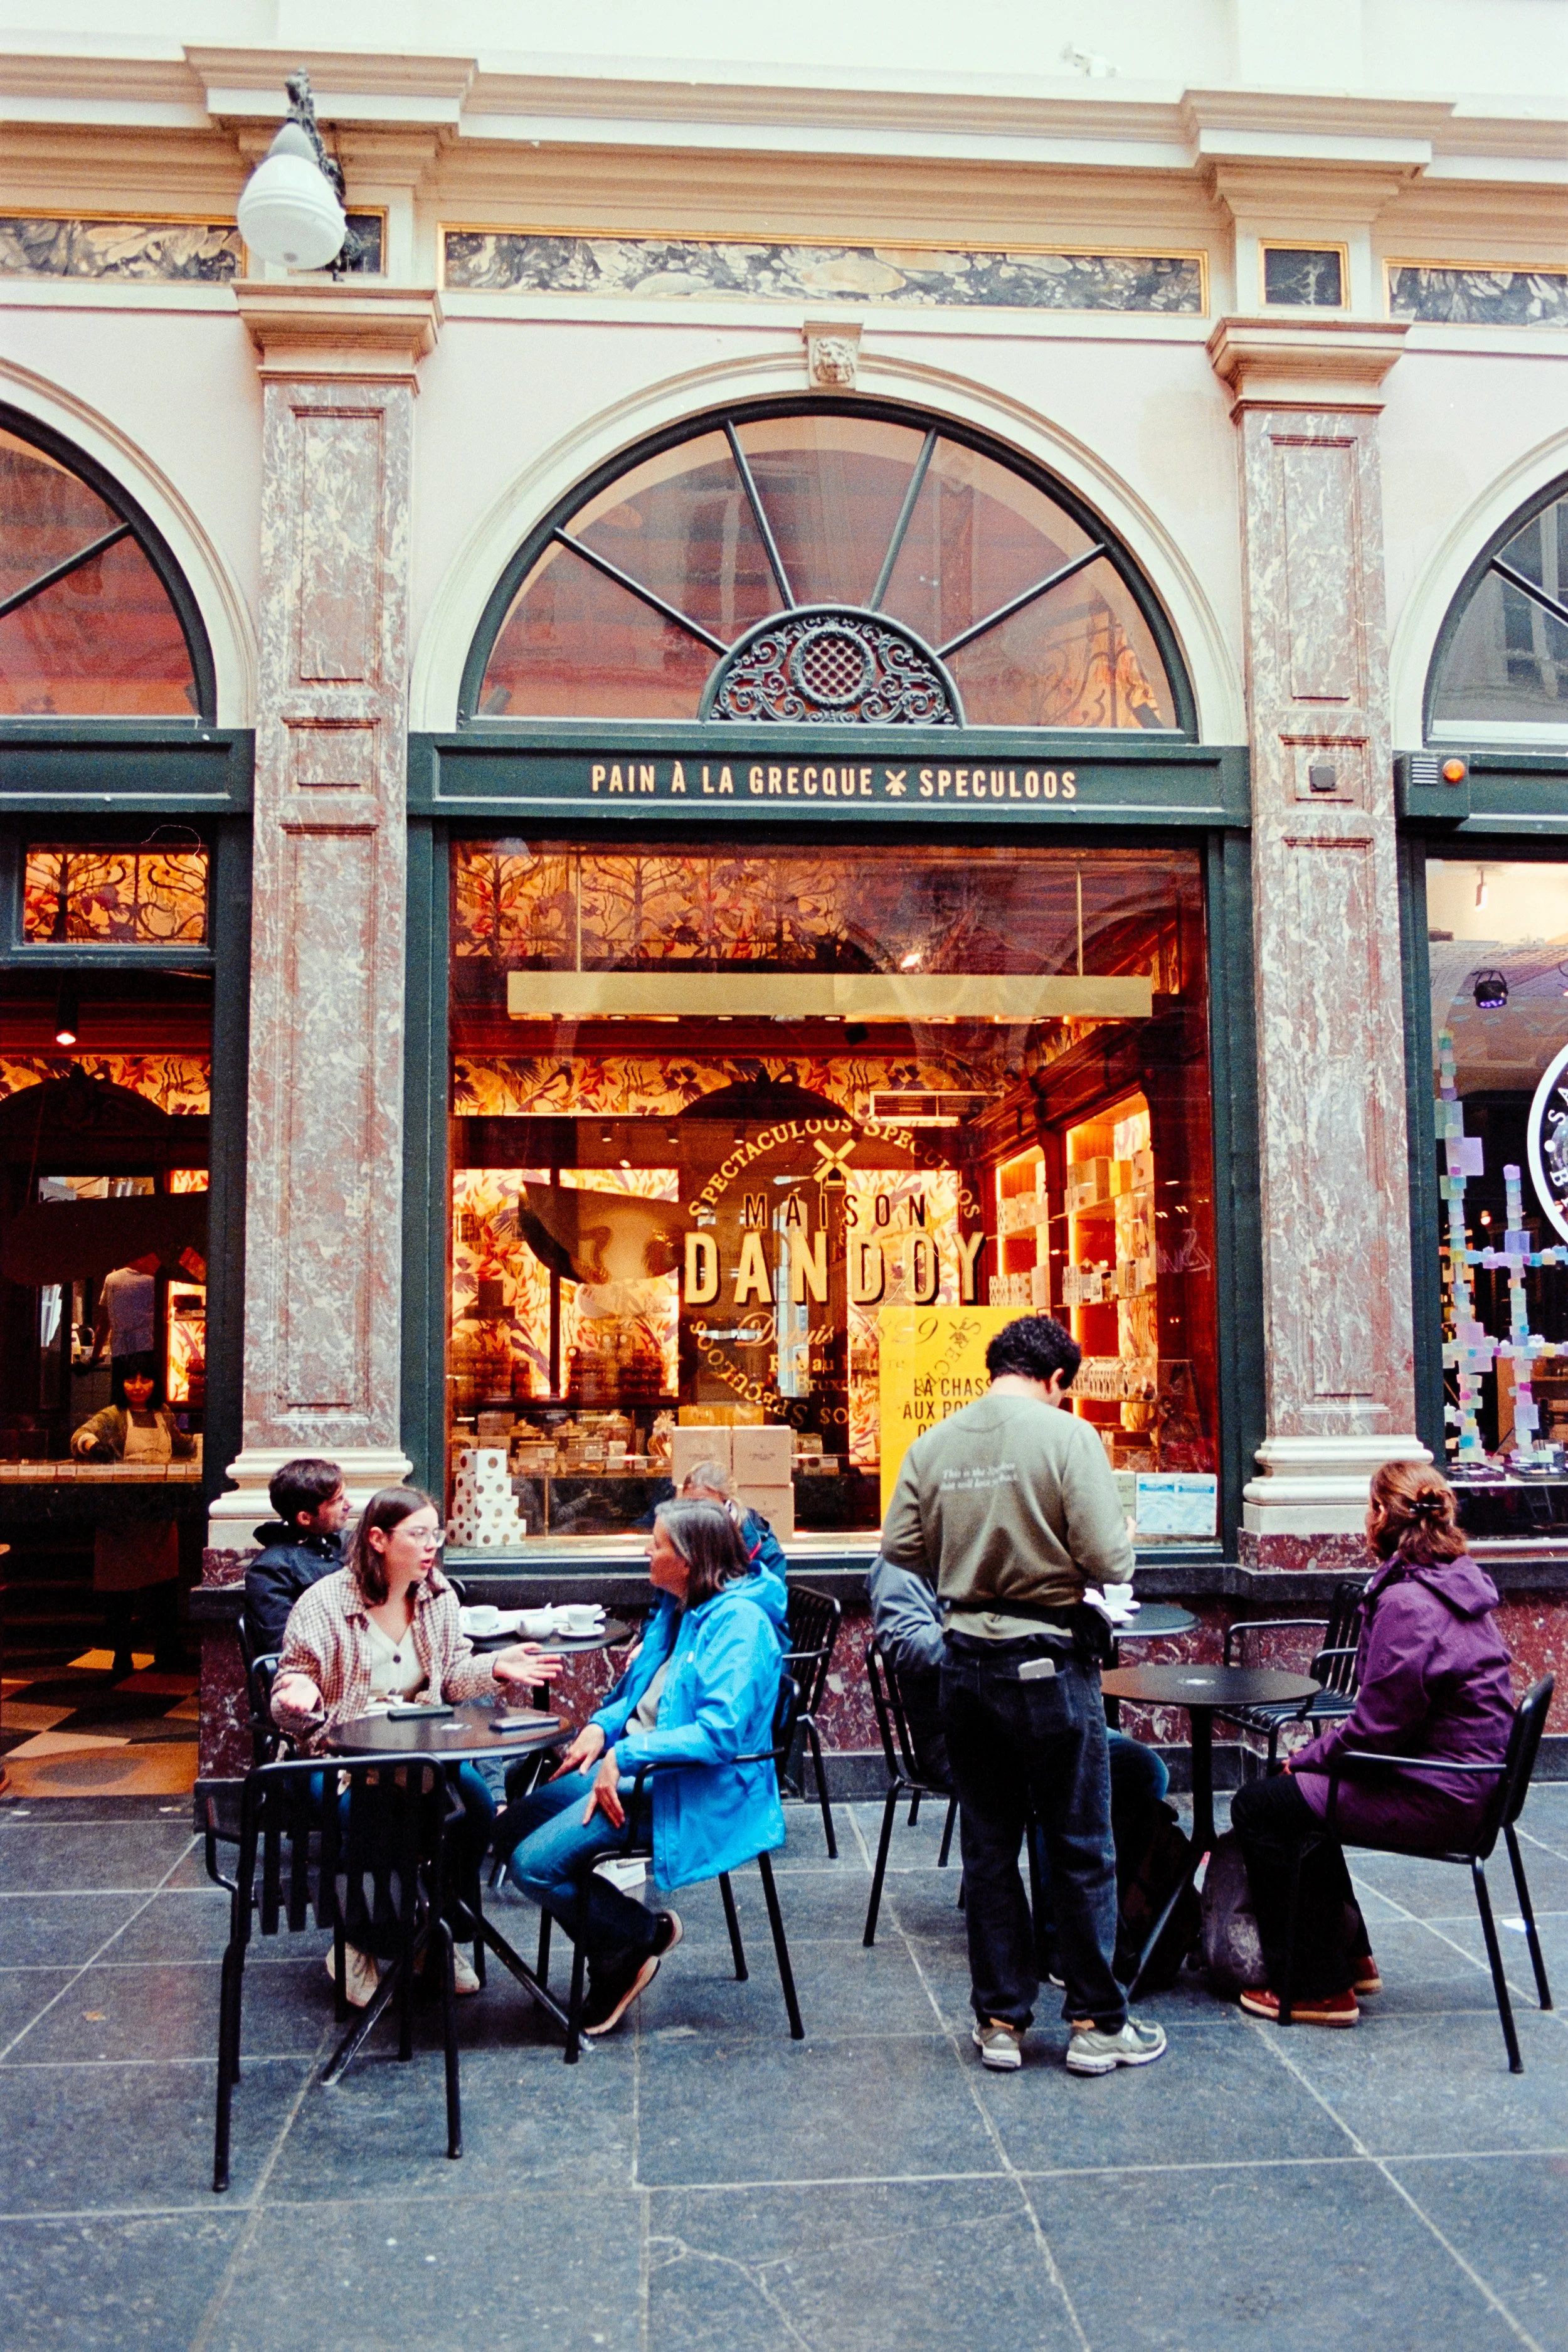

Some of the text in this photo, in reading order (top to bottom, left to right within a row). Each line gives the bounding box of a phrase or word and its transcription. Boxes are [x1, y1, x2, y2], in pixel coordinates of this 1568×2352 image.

[591, 761, 1077, 798] PAIN À LA GRECQUE SPECULOOS
[689, 1116, 853, 1217] SPECTACULOOS
[743, 1192, 927, 1231] MAISON
[684, 1232, 988, 1305] DANDOY
[914, 1378, 933, 1397] LA
[903, 1401, 935, 1419] AUX
